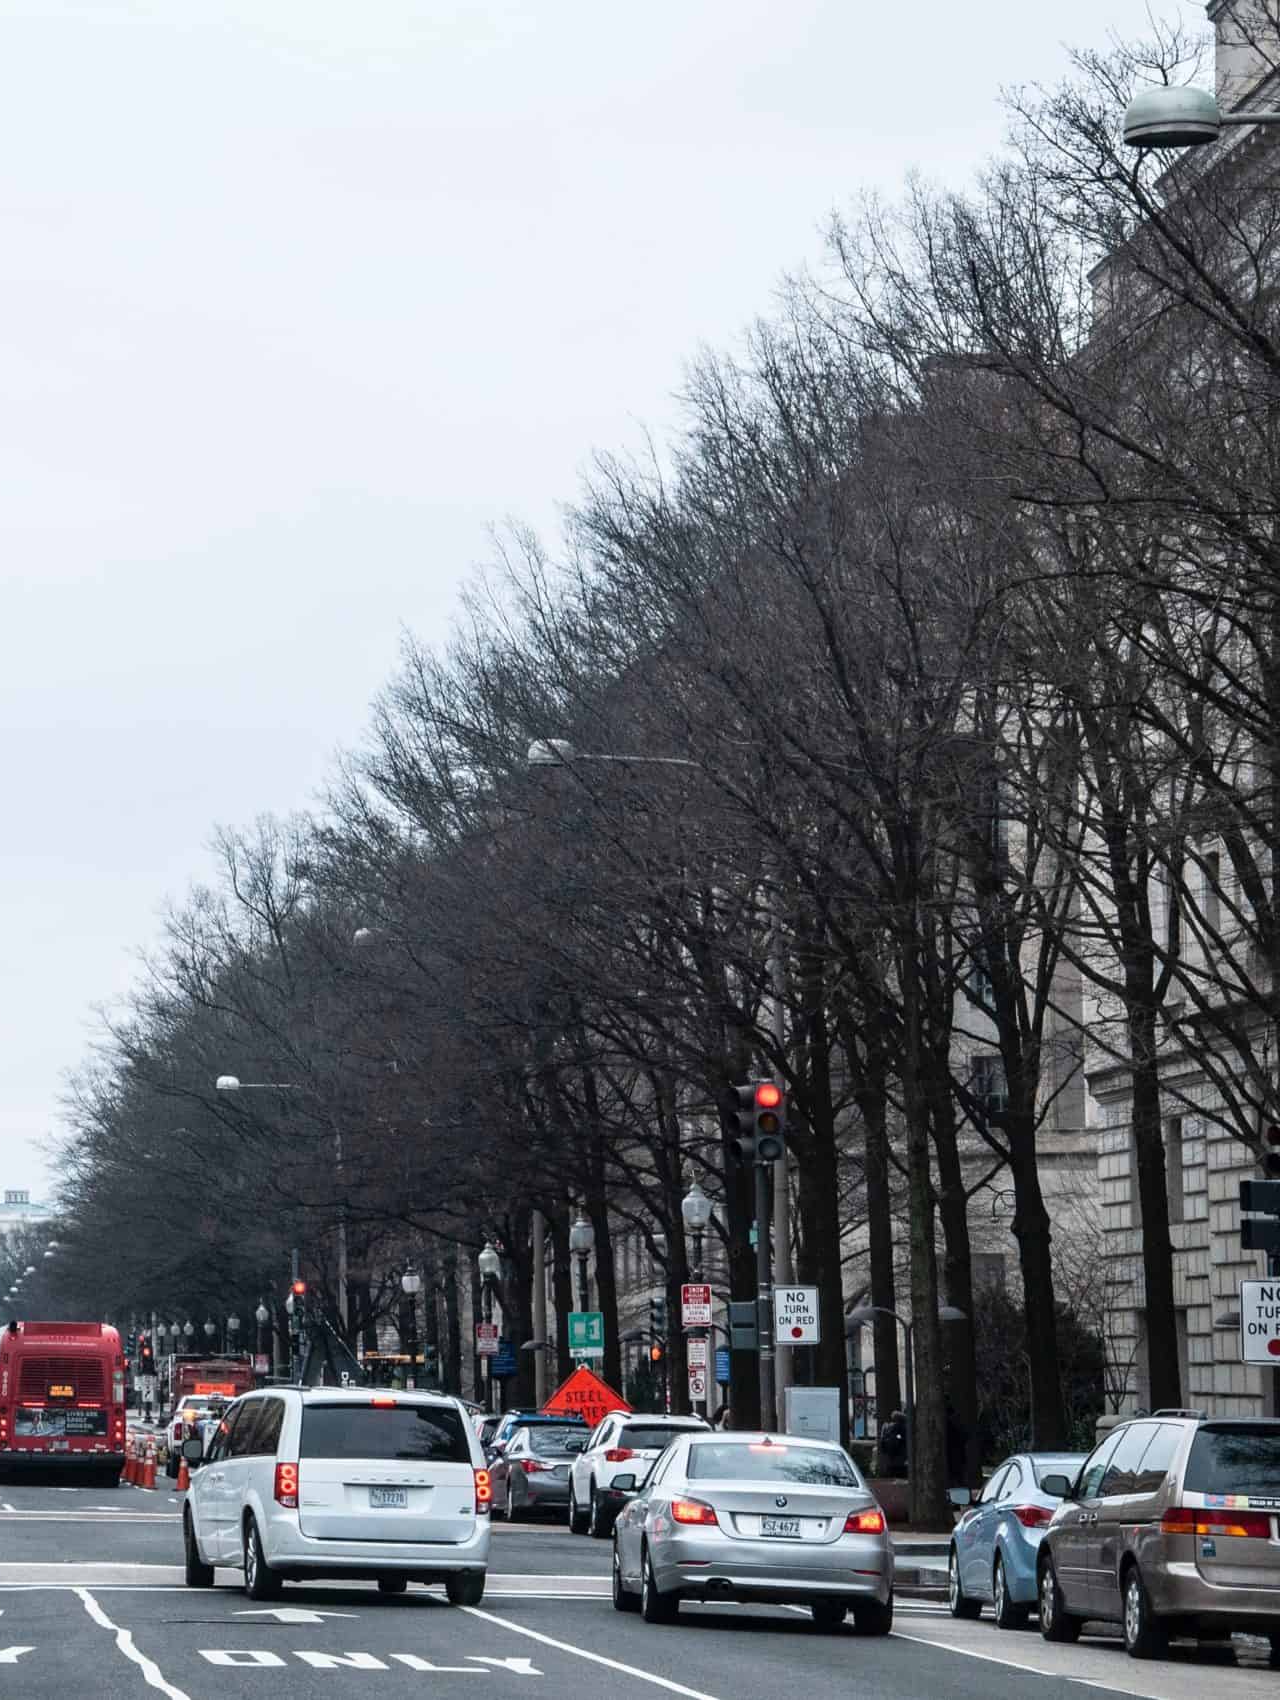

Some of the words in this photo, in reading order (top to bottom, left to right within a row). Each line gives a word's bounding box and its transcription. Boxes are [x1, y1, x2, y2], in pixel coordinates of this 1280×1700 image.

[786, 1292, 805, 1303] NO
[1261, 1287, 1280, 1302] N
[784, 1305, 809, 1313] TURN
[778, 1316, 792, 1325] ON
[795, 1316, 815, 1325] RED
[1248, 1323, 1268, 1335] ON
[566, 1392, 604, 1402] STEEL
[197, 1650, 544, 1675] ONLY
